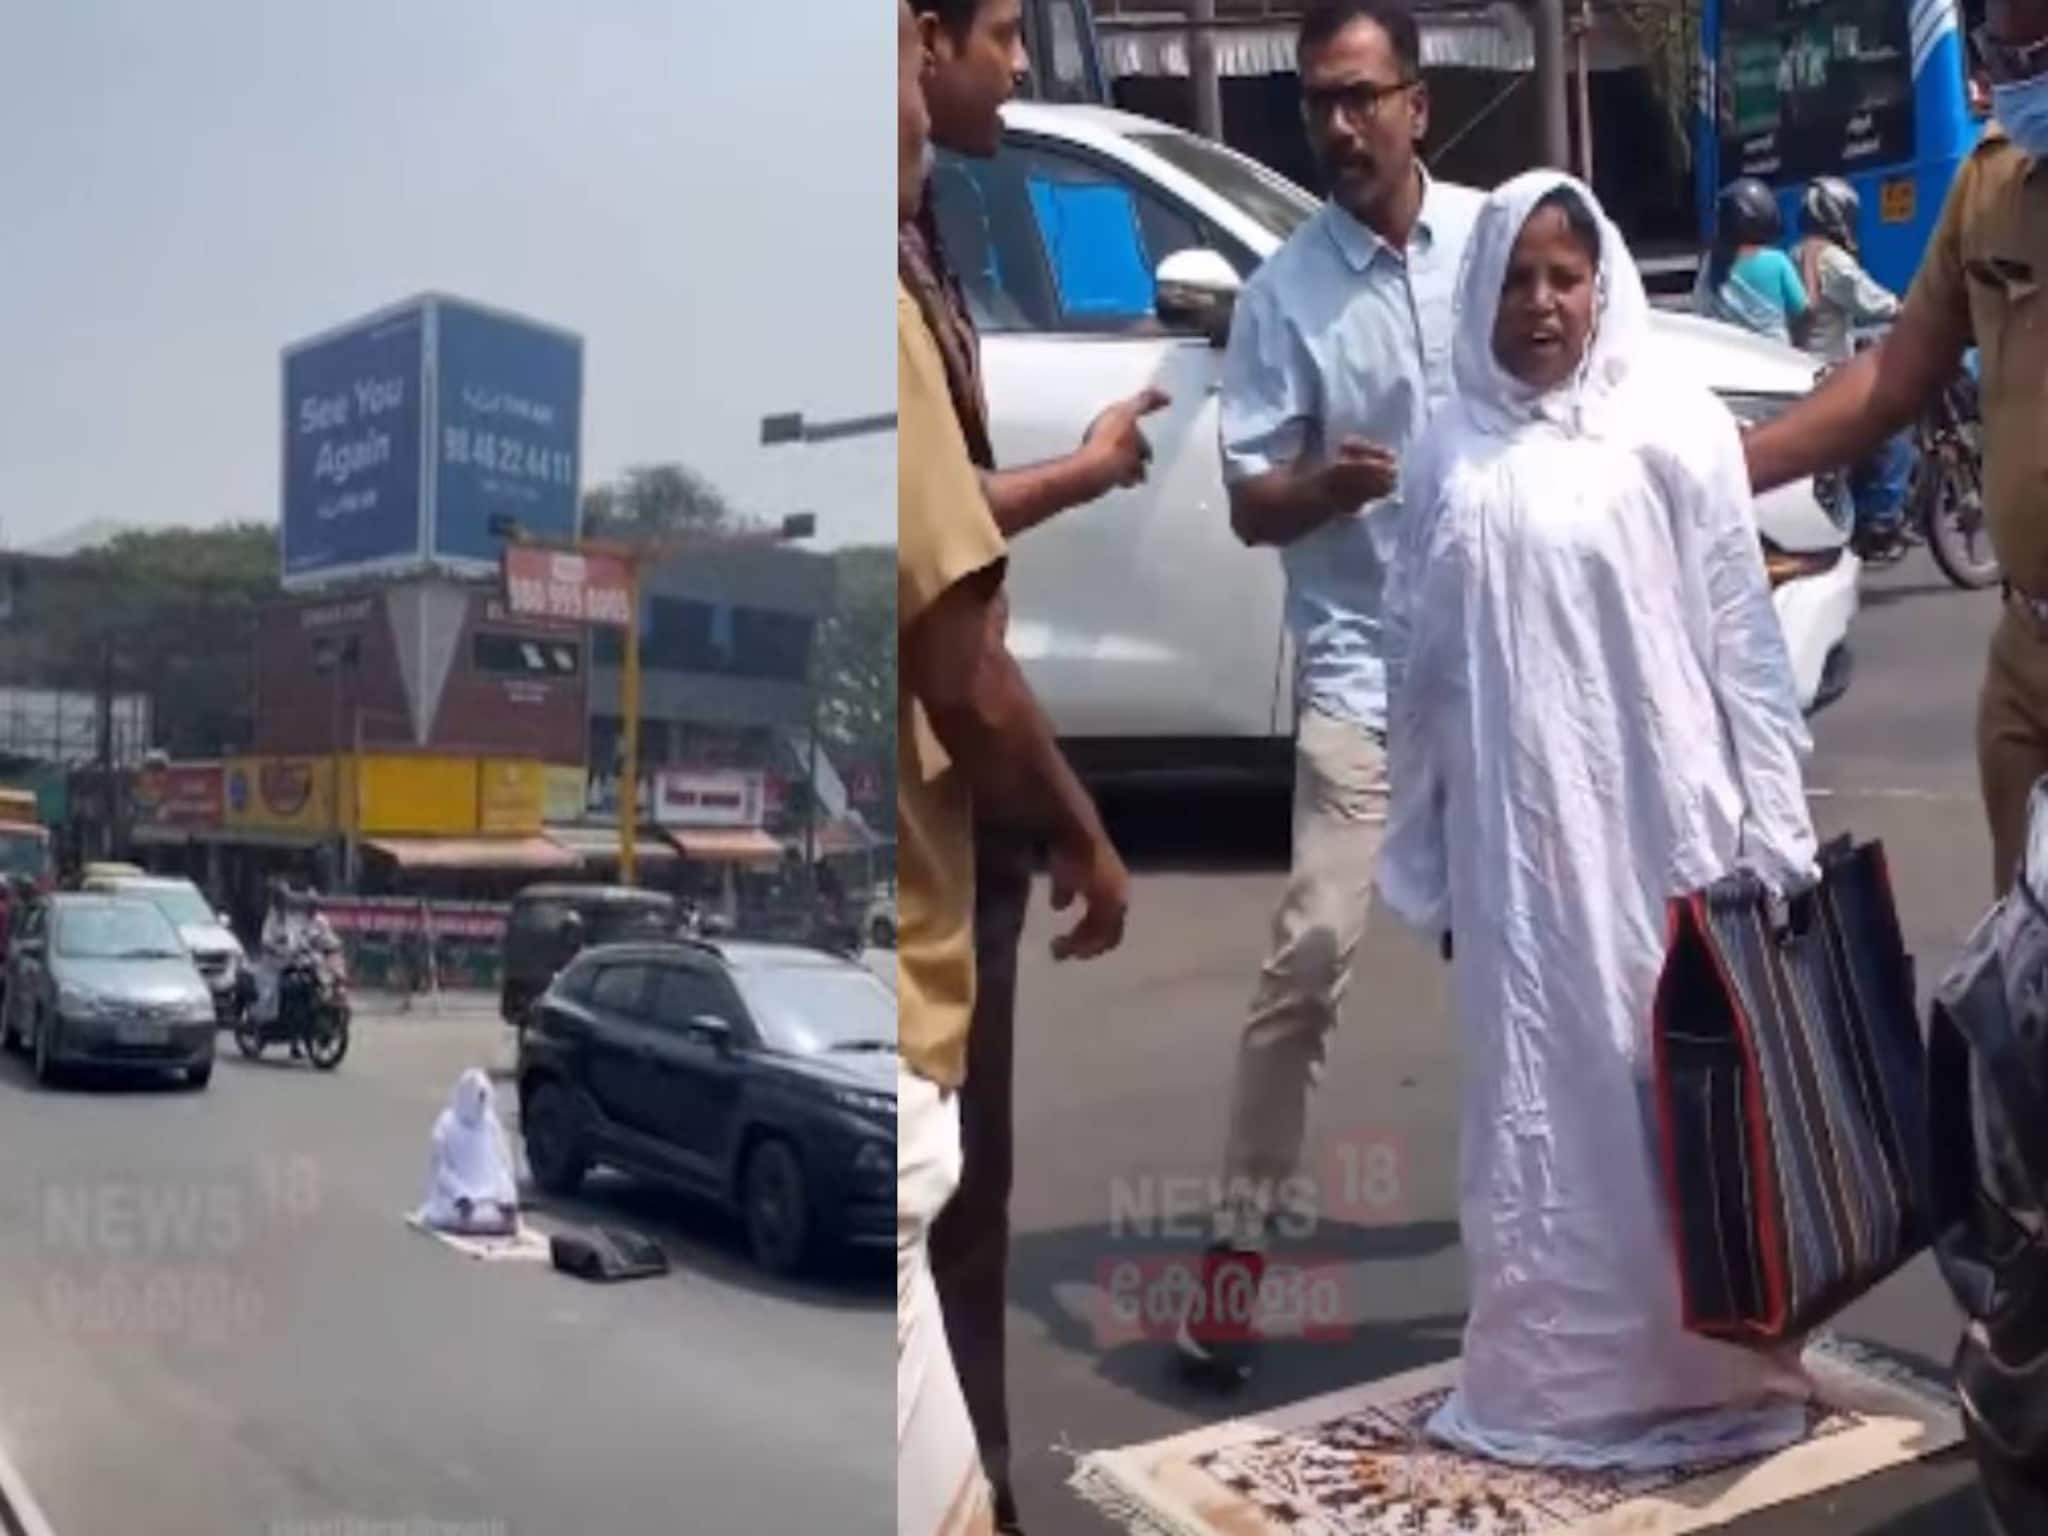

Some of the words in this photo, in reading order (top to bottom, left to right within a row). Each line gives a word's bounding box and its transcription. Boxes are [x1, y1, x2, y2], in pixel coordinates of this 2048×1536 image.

[301, 394, 349, 435] See
[354, 376, 404, 416] You
[314, 428, 392, 485] Again
